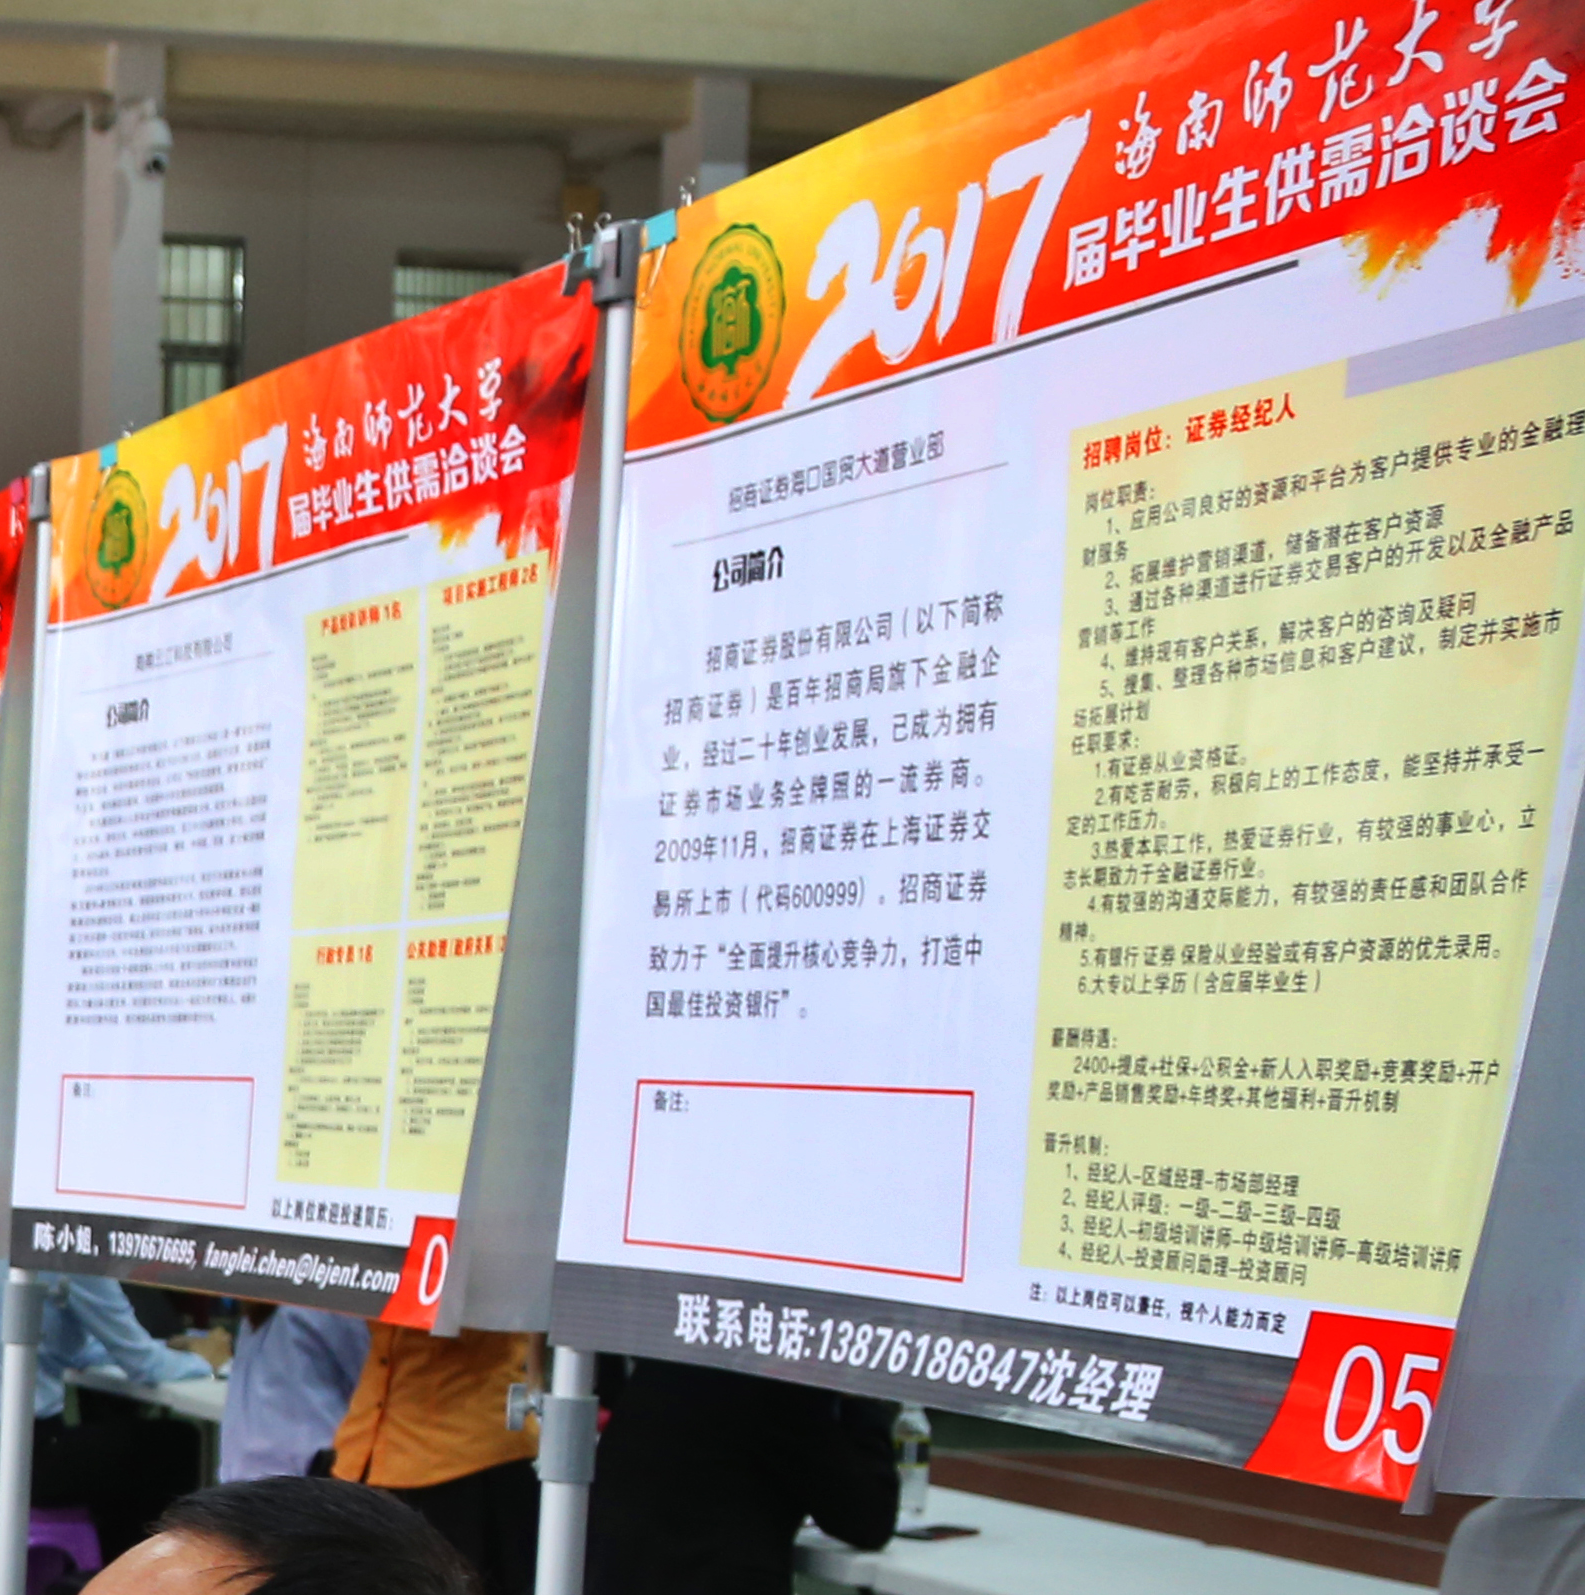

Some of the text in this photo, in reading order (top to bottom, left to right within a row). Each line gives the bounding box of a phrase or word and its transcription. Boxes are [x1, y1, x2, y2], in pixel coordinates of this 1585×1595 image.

[1064, 58, 1570, 291] 届毕业生供需洽谈会
[781, 111, 1092, 411] 2017
[149, 421, 288, 604] 2017
[288, 424, 526, 540] 届毕业生供需洽谈会
[712, 545, 784, 592] 公司简介
[1323, 1344, 1440, 1465] 05
